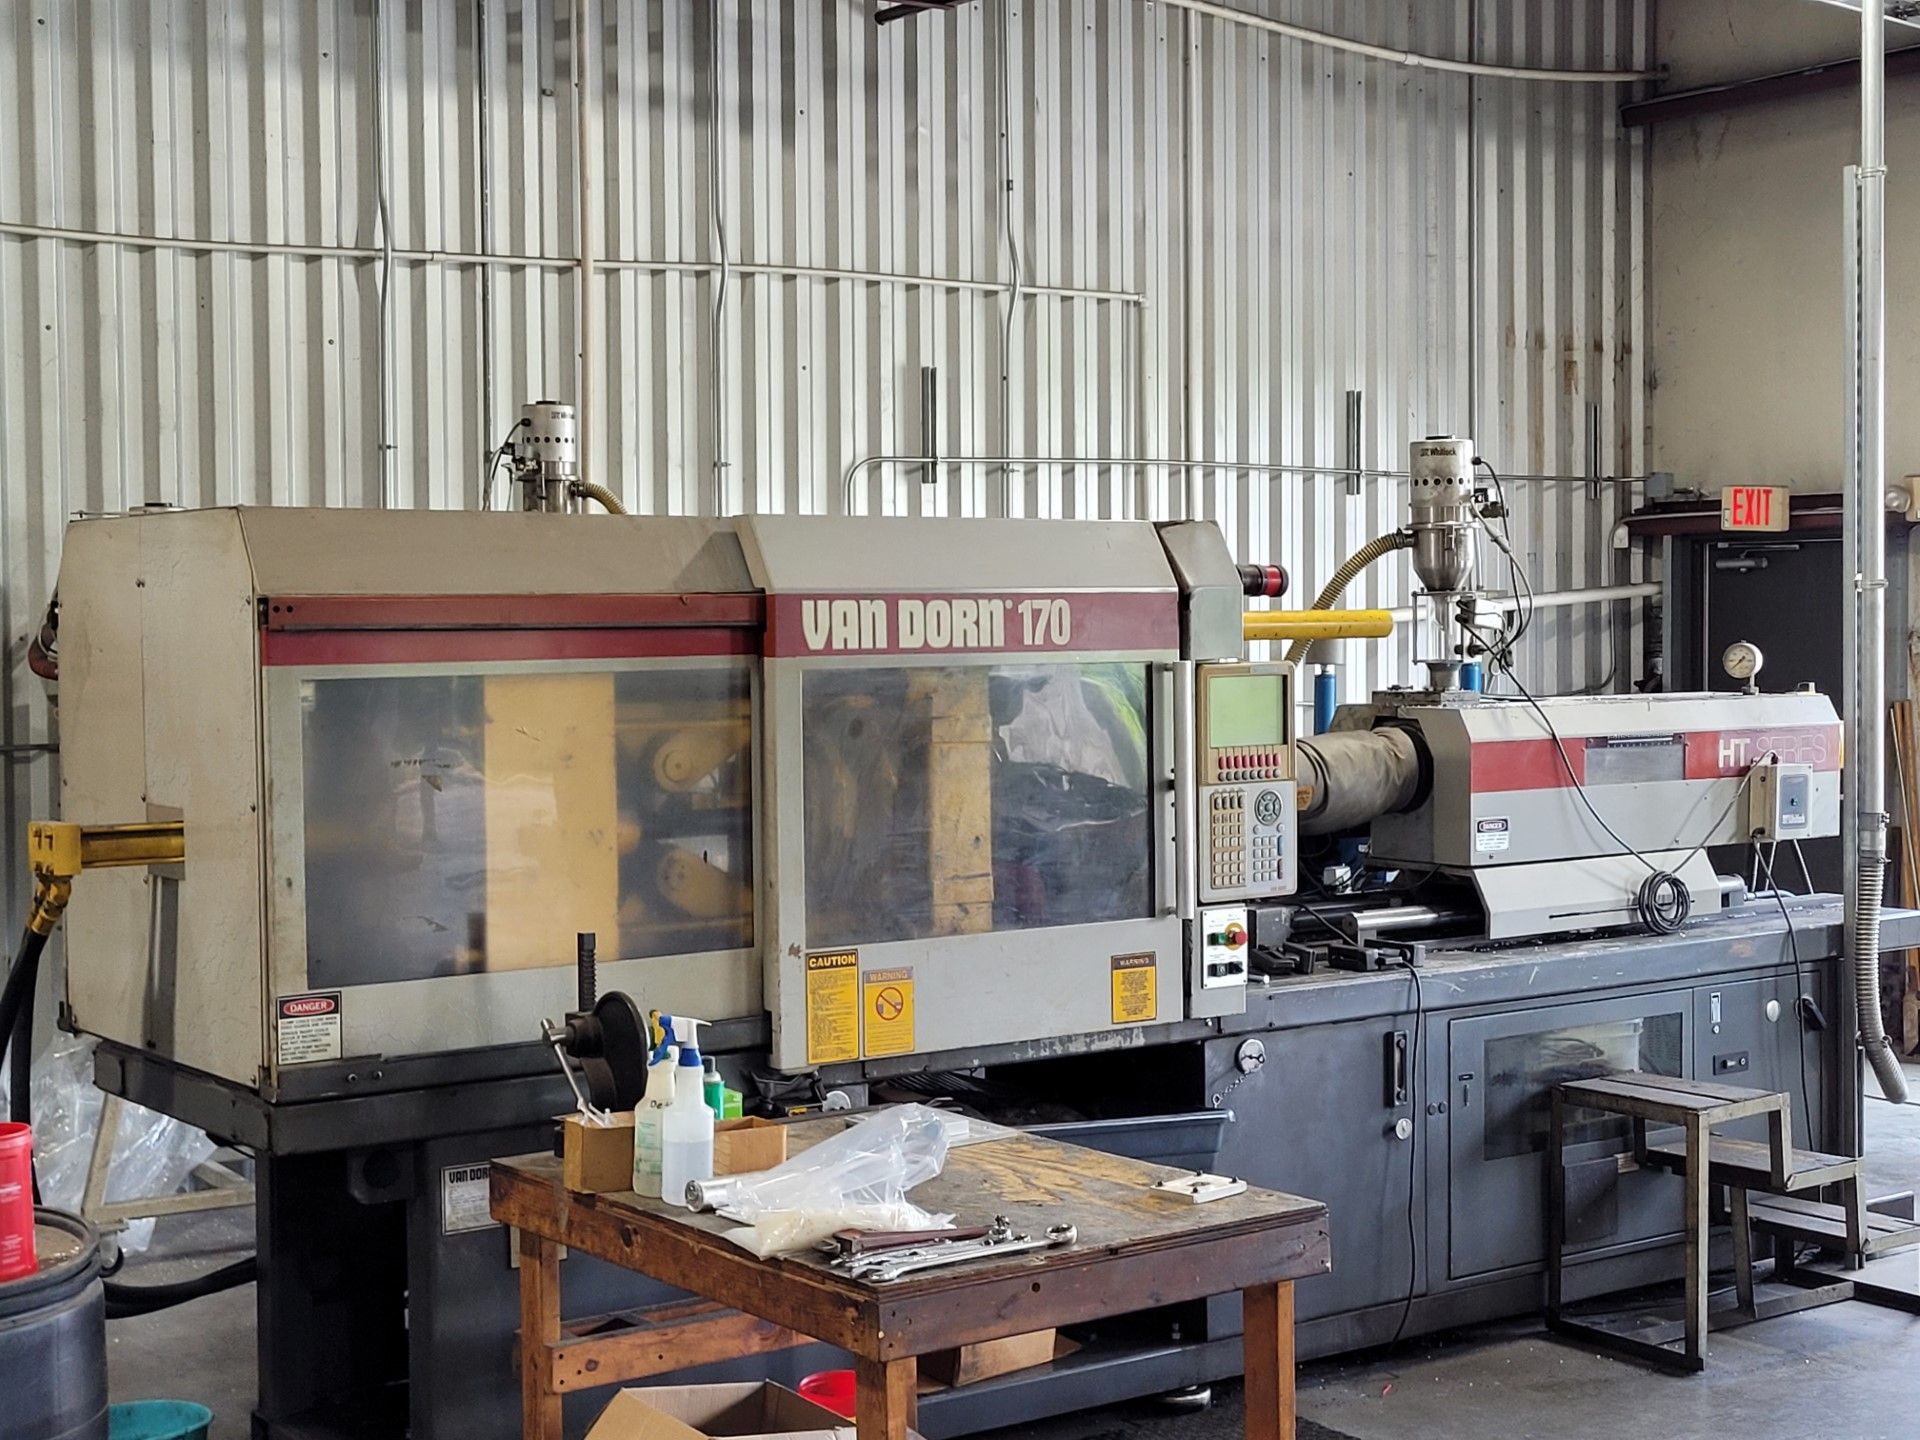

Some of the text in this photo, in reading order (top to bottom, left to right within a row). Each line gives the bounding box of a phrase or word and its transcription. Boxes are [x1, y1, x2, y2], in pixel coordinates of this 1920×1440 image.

[1732, 488, 1773, 526] EXIT
[802, 598, 1072, 650] VAN DORN 170
[1718, 737, 1751, 768] HT
[809, 954, 856, 967] CAUTION
[869, 970, 909, 982] WARNING
[289, 1001, 328, 1013] DANGER
[448, 1167, 489, 1184] VAN DOR
